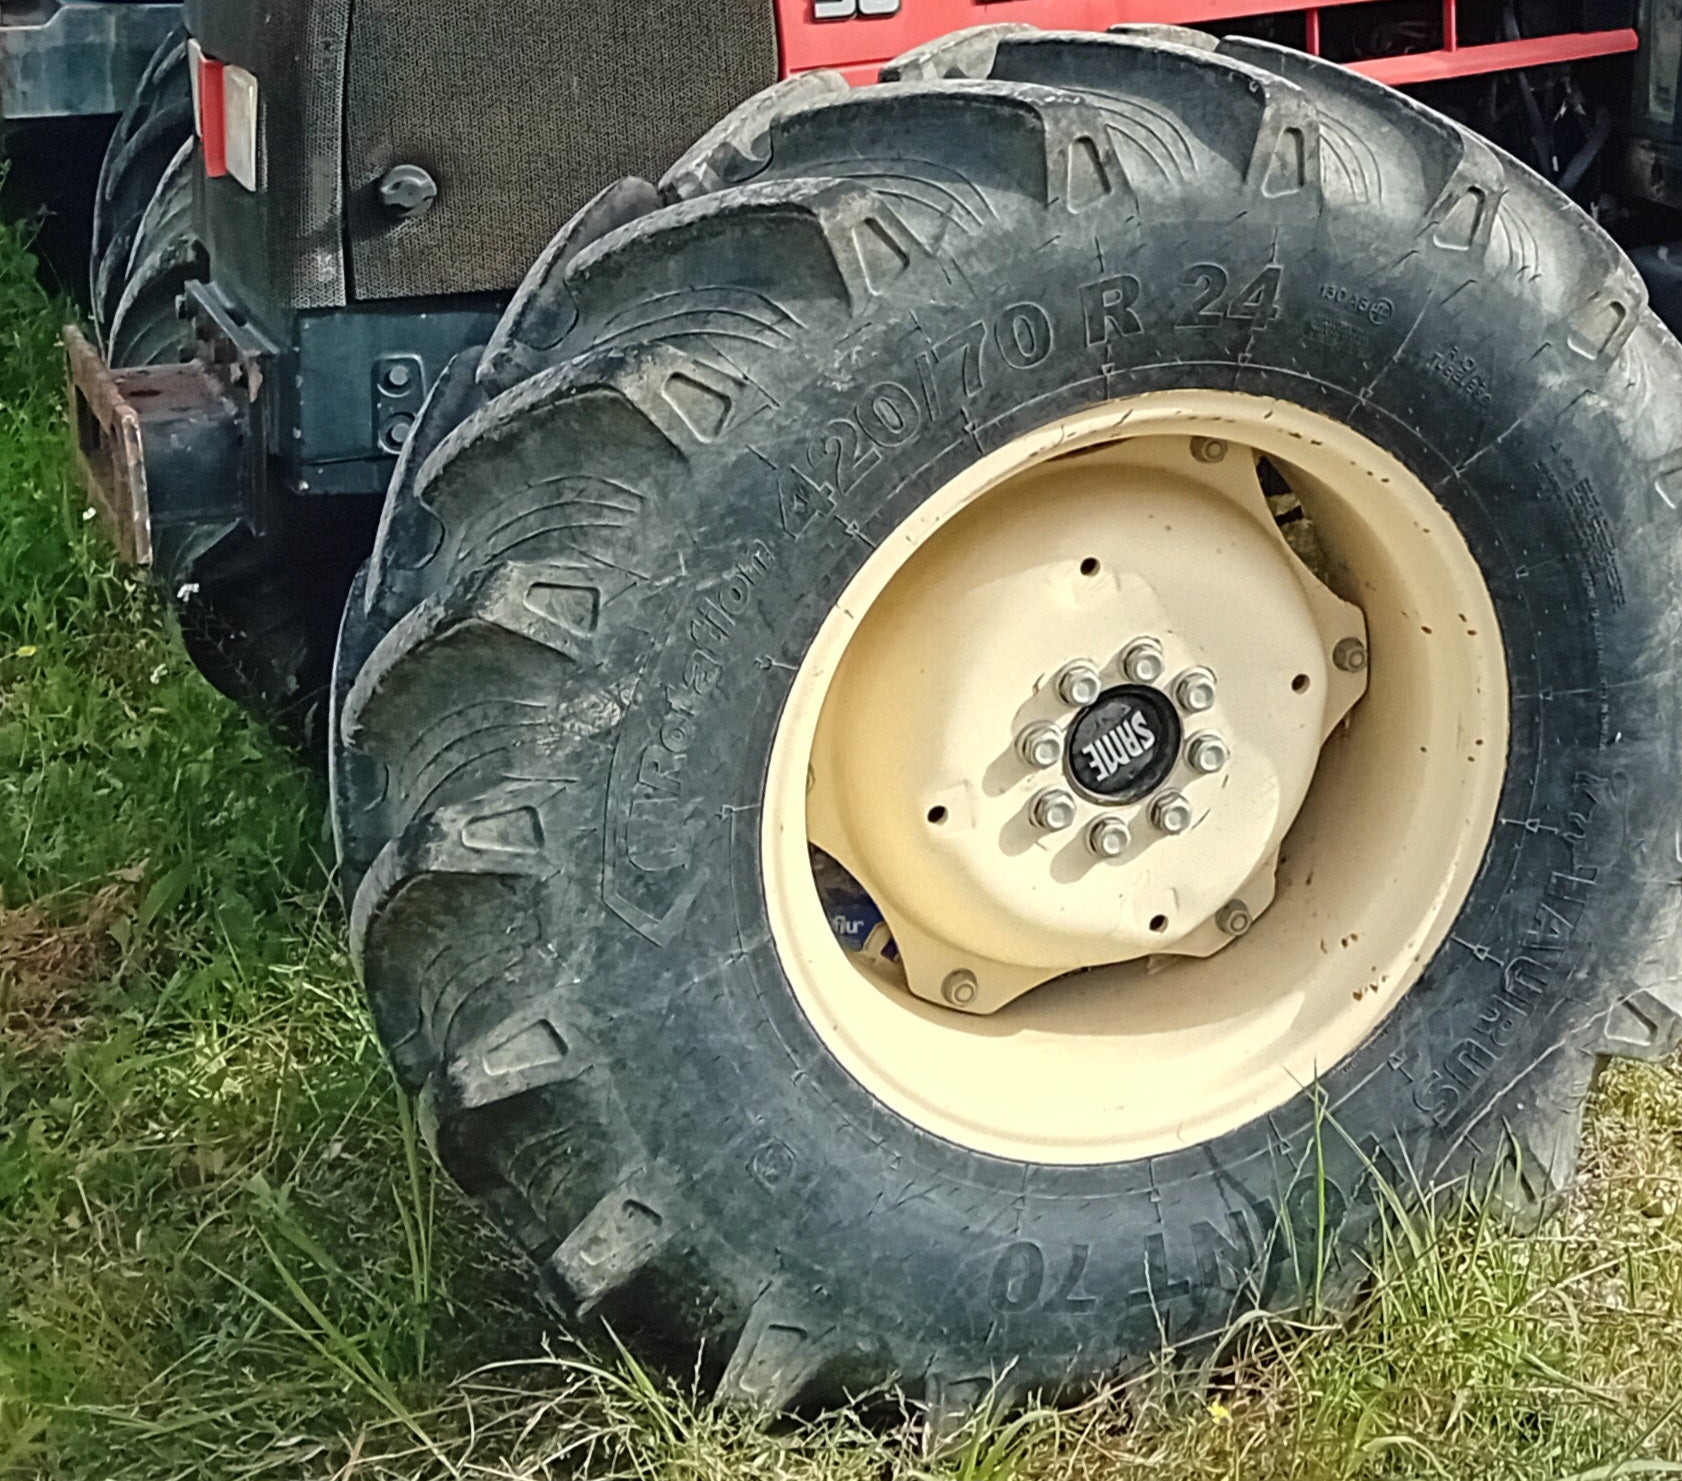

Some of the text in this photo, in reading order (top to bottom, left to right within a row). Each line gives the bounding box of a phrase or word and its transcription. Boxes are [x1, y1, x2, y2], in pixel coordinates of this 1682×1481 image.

[1079, 273, 1145, 348] R
[1174, 263, 1285, 331] 24
[1081, 710, 1156, 782] SAME
[1411, 865, 1600, 1127] TAURUS
[987, 1239, 1097, 1314] 70
